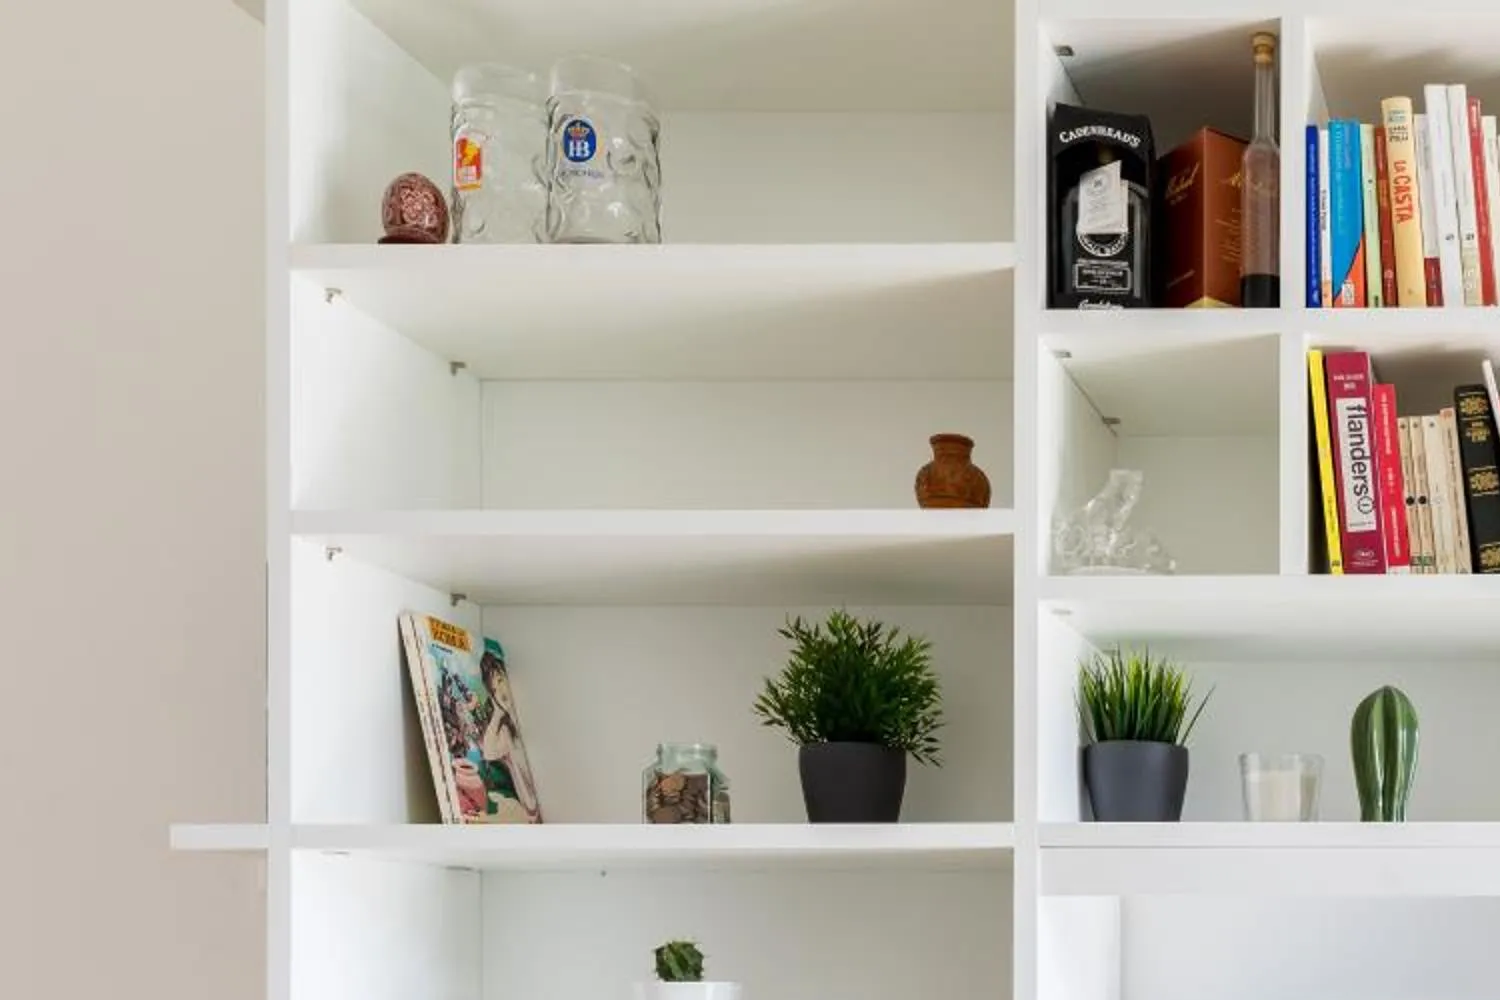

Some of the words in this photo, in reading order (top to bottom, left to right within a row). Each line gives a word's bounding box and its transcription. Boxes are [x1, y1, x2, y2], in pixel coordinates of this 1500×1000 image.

[568, 140, 590, 158] HB
[1059, 125, 1141, 149] CADENHEAD'S
[1393, 174, 1414, 225] CASTA
[1345, 404, 1372, 498] flanders
